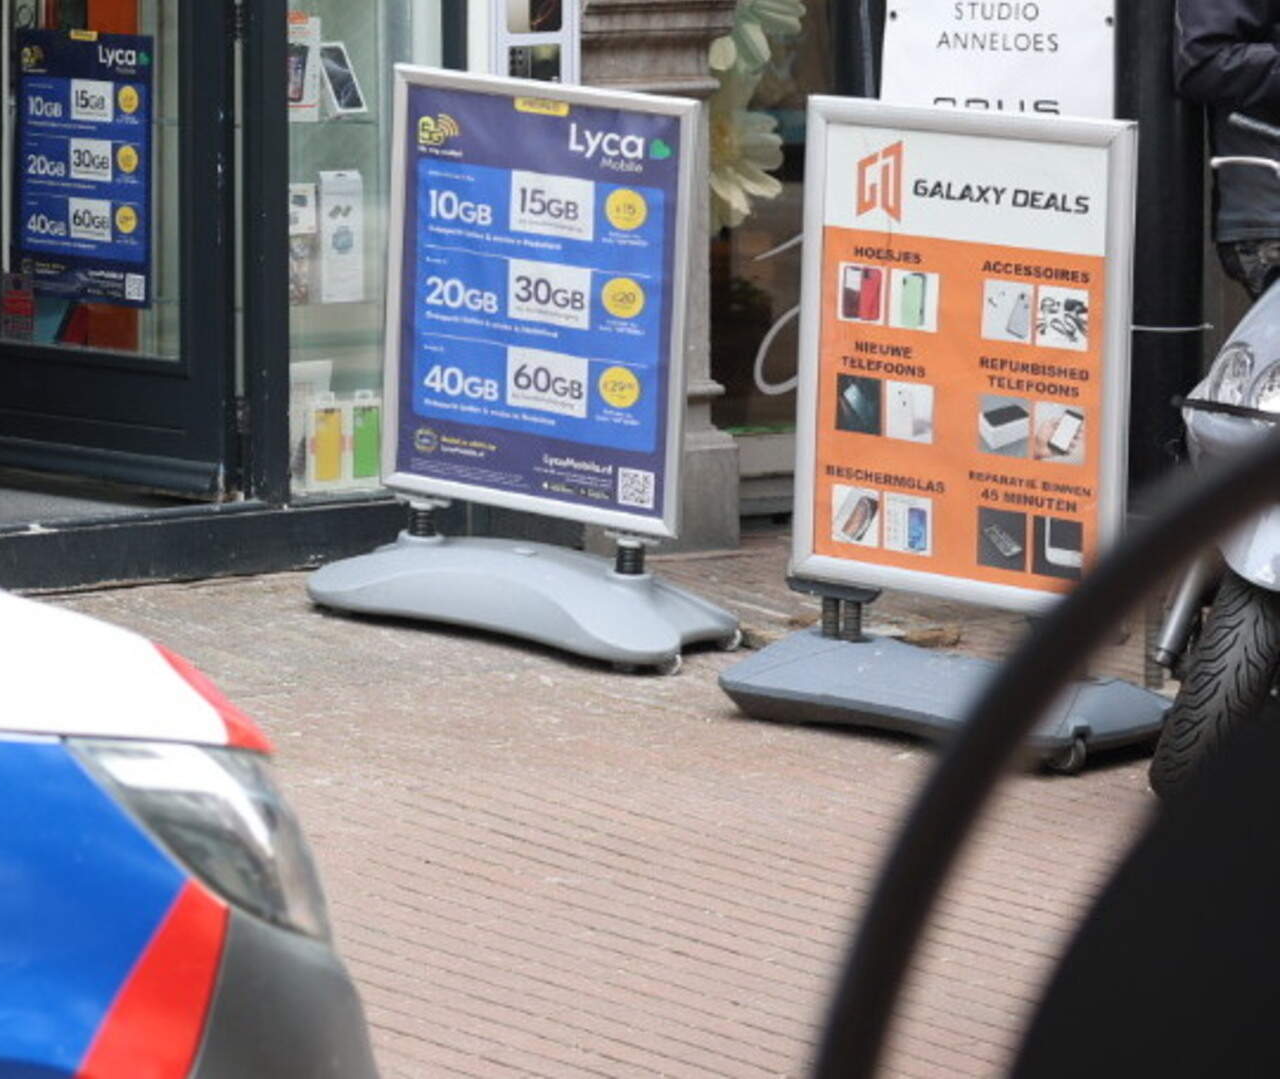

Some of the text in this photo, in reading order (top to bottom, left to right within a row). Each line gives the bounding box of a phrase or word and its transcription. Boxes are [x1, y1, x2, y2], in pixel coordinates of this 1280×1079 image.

[954, 2, 1040, 21] STUDIO
[936, 31, 1059, 52] ANNELOES
[98, 45, 137, 68] Lyca
[27, 89, 105, 119] 10GB 15GB
[568, 123, 646, 160] Lyca
[27, 149, 110, 177] 20GB 30GB
[600, 157, 644, 173] Mobile
[429, 189, 493, 226] 10GB
[520, 187, 579, 221] 15GB
[913, 179, 1007, 206] GALAXY
[1012, 189, 1090, 215] DEALS
[26, 208, 109, 238] 40GB 60GB
[854, 246, 922, 264] HOESJES
[981, 260, 1090, 284] ACCESSOIRES
[425, 276, 498, 314] 20GB
[514, 275, 585, 311] 30GB
[854, 341, 913, 360] NIEUWE
[842, 356, 926, 378] TELEFOONS
[979, 356, 1090, 382] REFURBISHED
[424, 365, 499, 402] 40GB
[513, 364, 584, 400] 60GB
[987, 374, 1080, 398] TELEFOONS
[825, 464, 946, 494] BESCHERMGLAS
[968, 470, 1092, 497] REPARATIE BINNEN
[980, 487, 1078, 513] 45 MINUTEN
